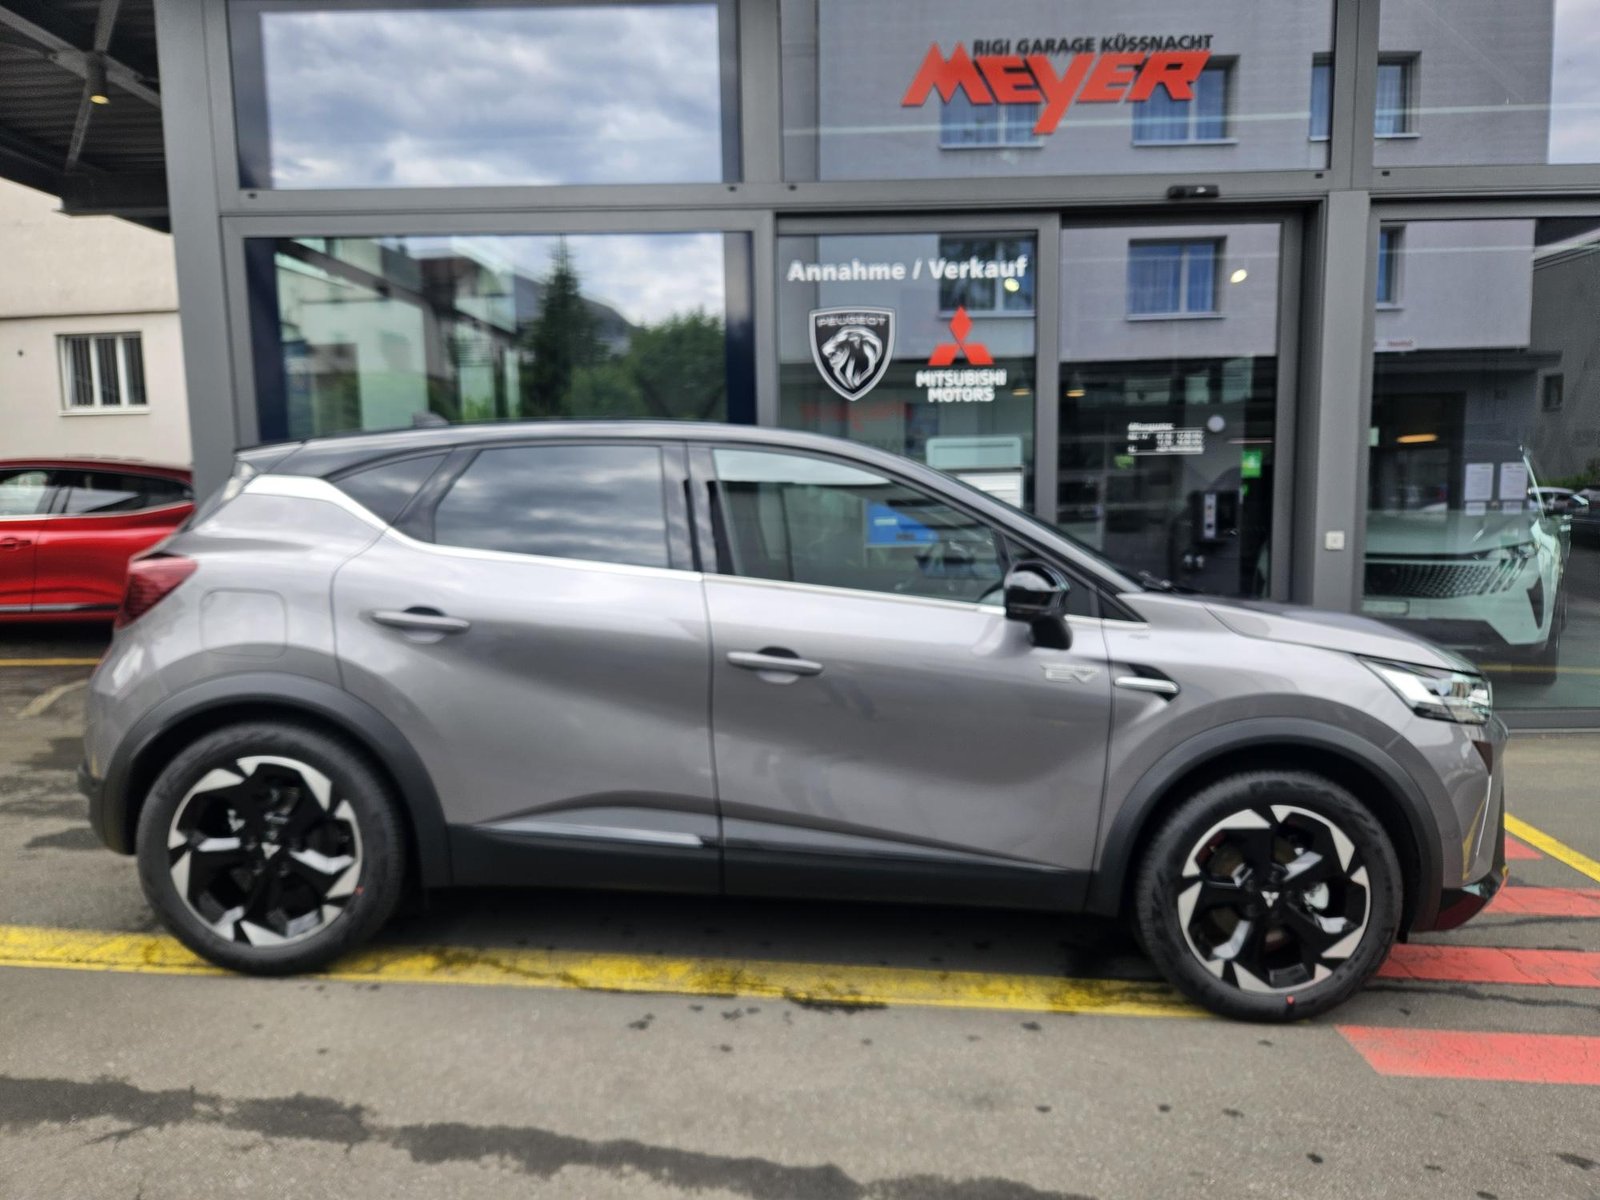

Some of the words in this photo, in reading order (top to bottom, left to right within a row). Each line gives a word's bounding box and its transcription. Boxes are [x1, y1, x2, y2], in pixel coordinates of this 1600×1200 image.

[972, 39, 1011, 55] RIGI
[1016, 37, 1096, 54] GARAGE
[1101, 34, 1214, 51] KÜSSNACHT
[902, 42, 1211, 134] MEYER
[788, 259, 905, 282] Annahme
[929, 255, 1028, 280] Verkauf
[816, 315, 886, 327] PEUGEOT
[916, 369, 1007, 387] MITSUBISHI
[928, 387, 995, 402] MOTORS
